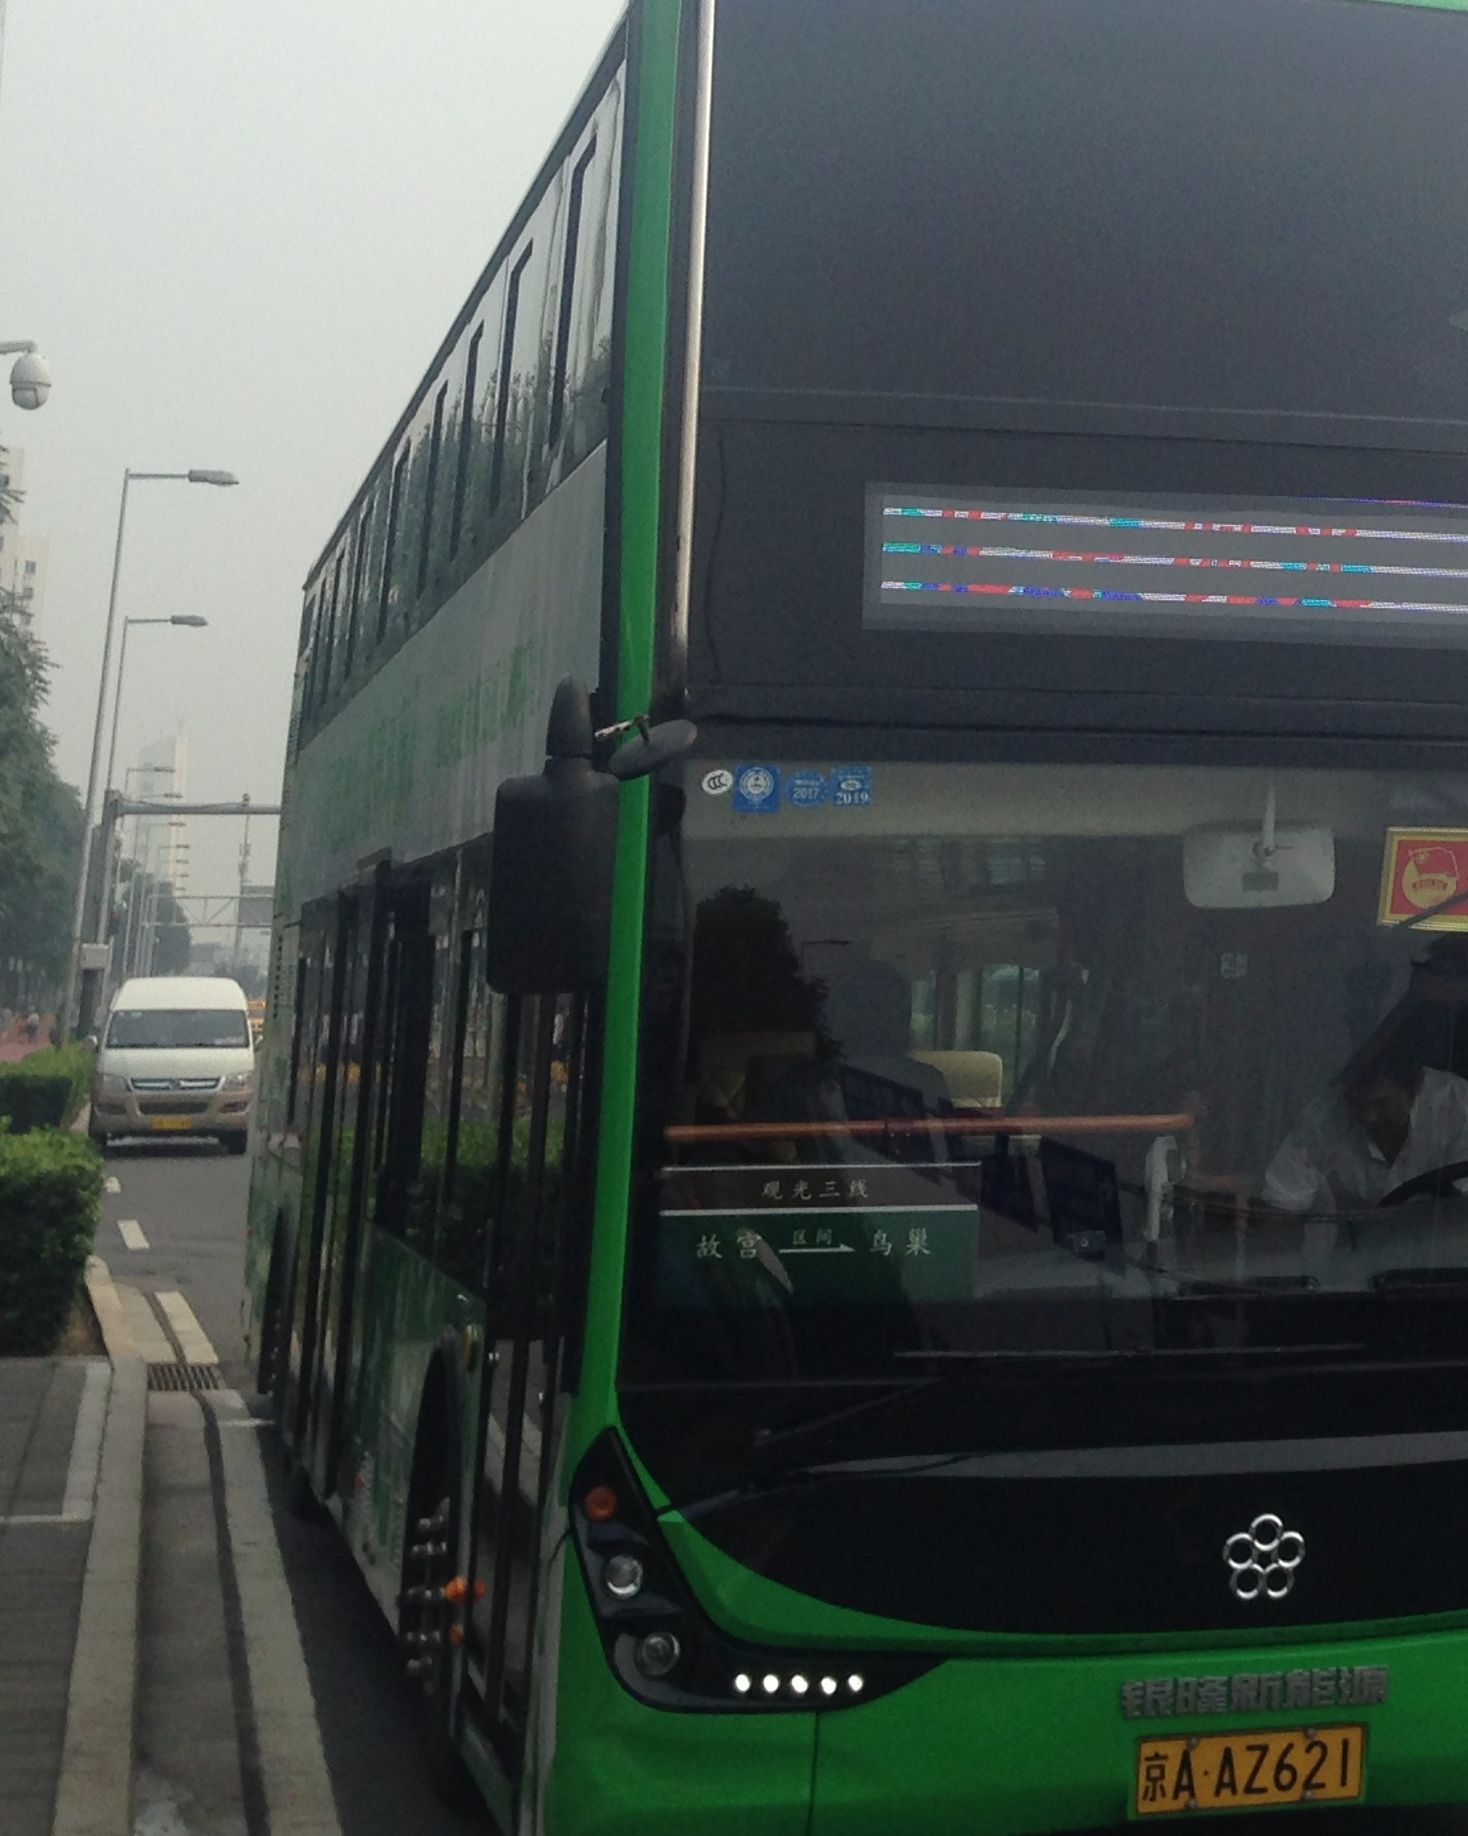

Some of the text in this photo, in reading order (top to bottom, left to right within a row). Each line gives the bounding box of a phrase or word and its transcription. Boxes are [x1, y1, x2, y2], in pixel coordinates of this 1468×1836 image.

[793, 787, 820, 800] 2017
[760, 1178, 870, 1201] 观光三线
[696, 1231, 763, 1259] 故宫
[792, 1228, 833, 1246] 区间
[869, 1228, 931, 1257] 鸟巢
[1122, 1666, 1387, 1718] 银隆新能源
